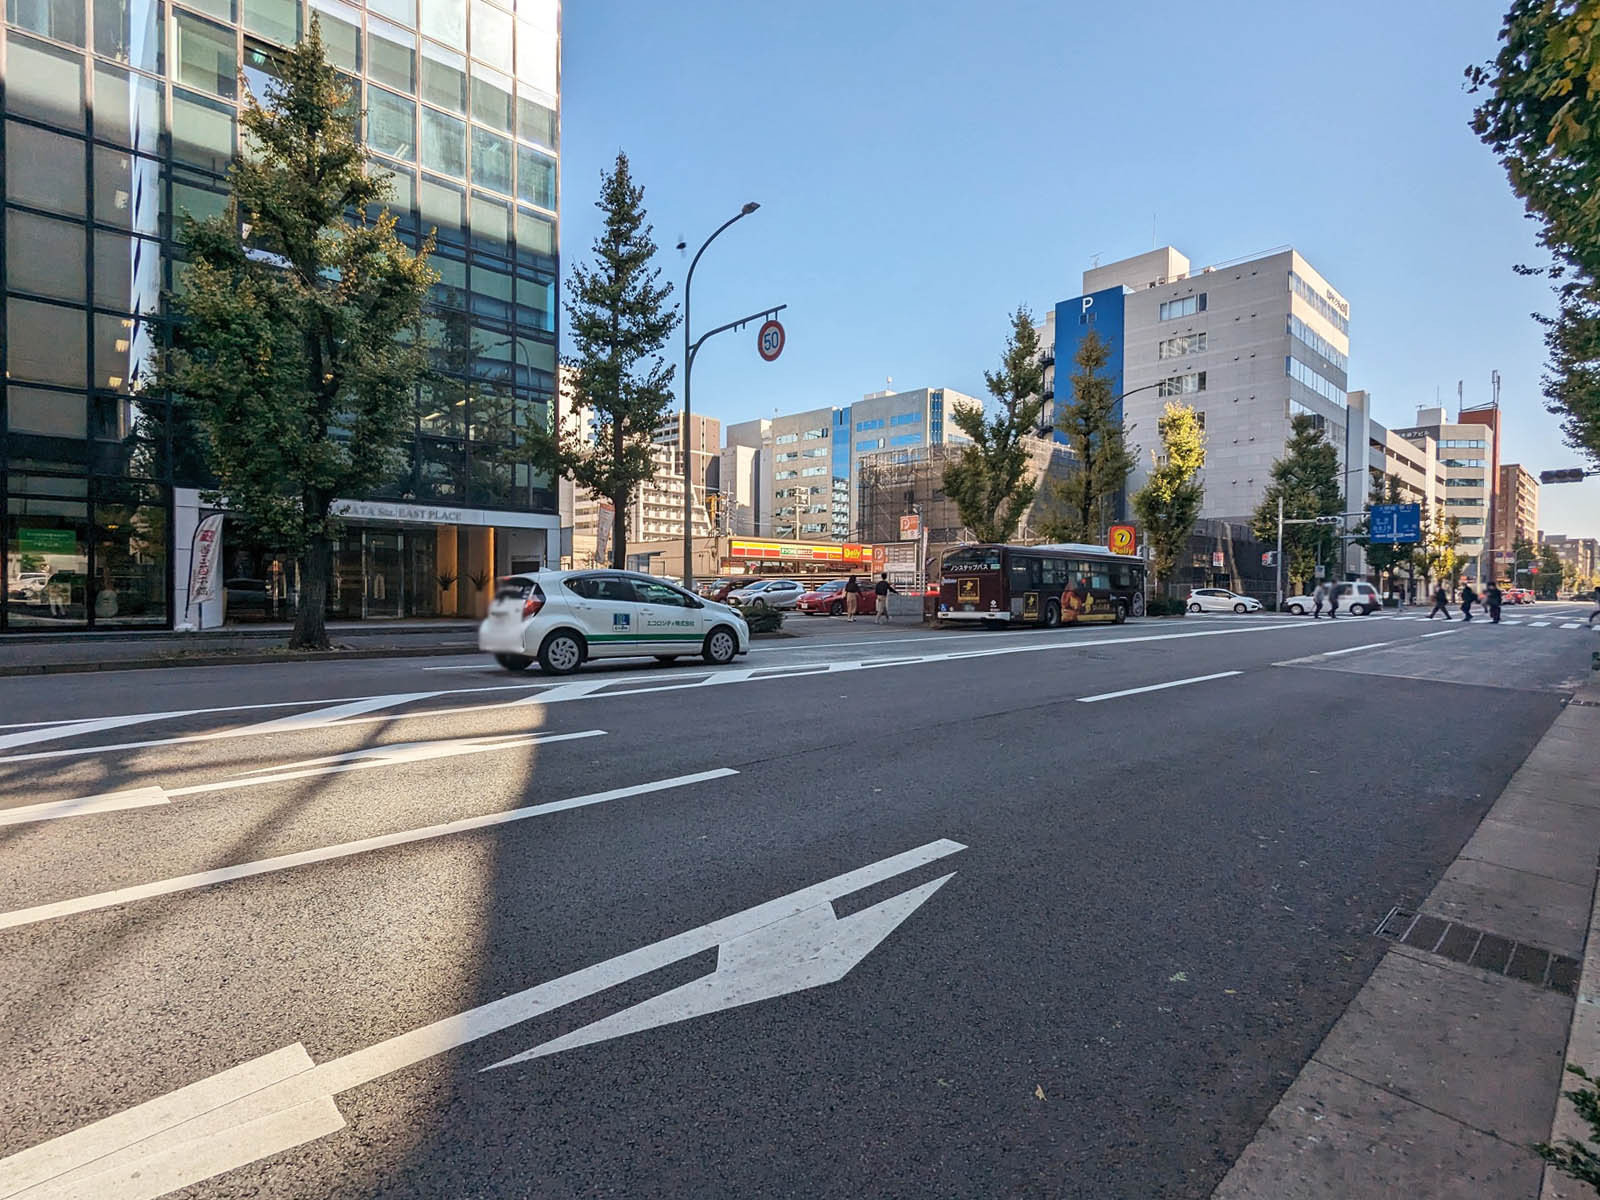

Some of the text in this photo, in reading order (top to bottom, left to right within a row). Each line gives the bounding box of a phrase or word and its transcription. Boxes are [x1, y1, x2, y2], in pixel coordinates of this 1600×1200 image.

[1082, 297, 1094, 313] P
[764, 331, 779, 351] 50
[398, 508, 426, 519] EAST
[428, 510, 462, 521] PLACE
[844, 548, 860, 560] Daily
[950, 563, 989, 572] ノンステップバス
